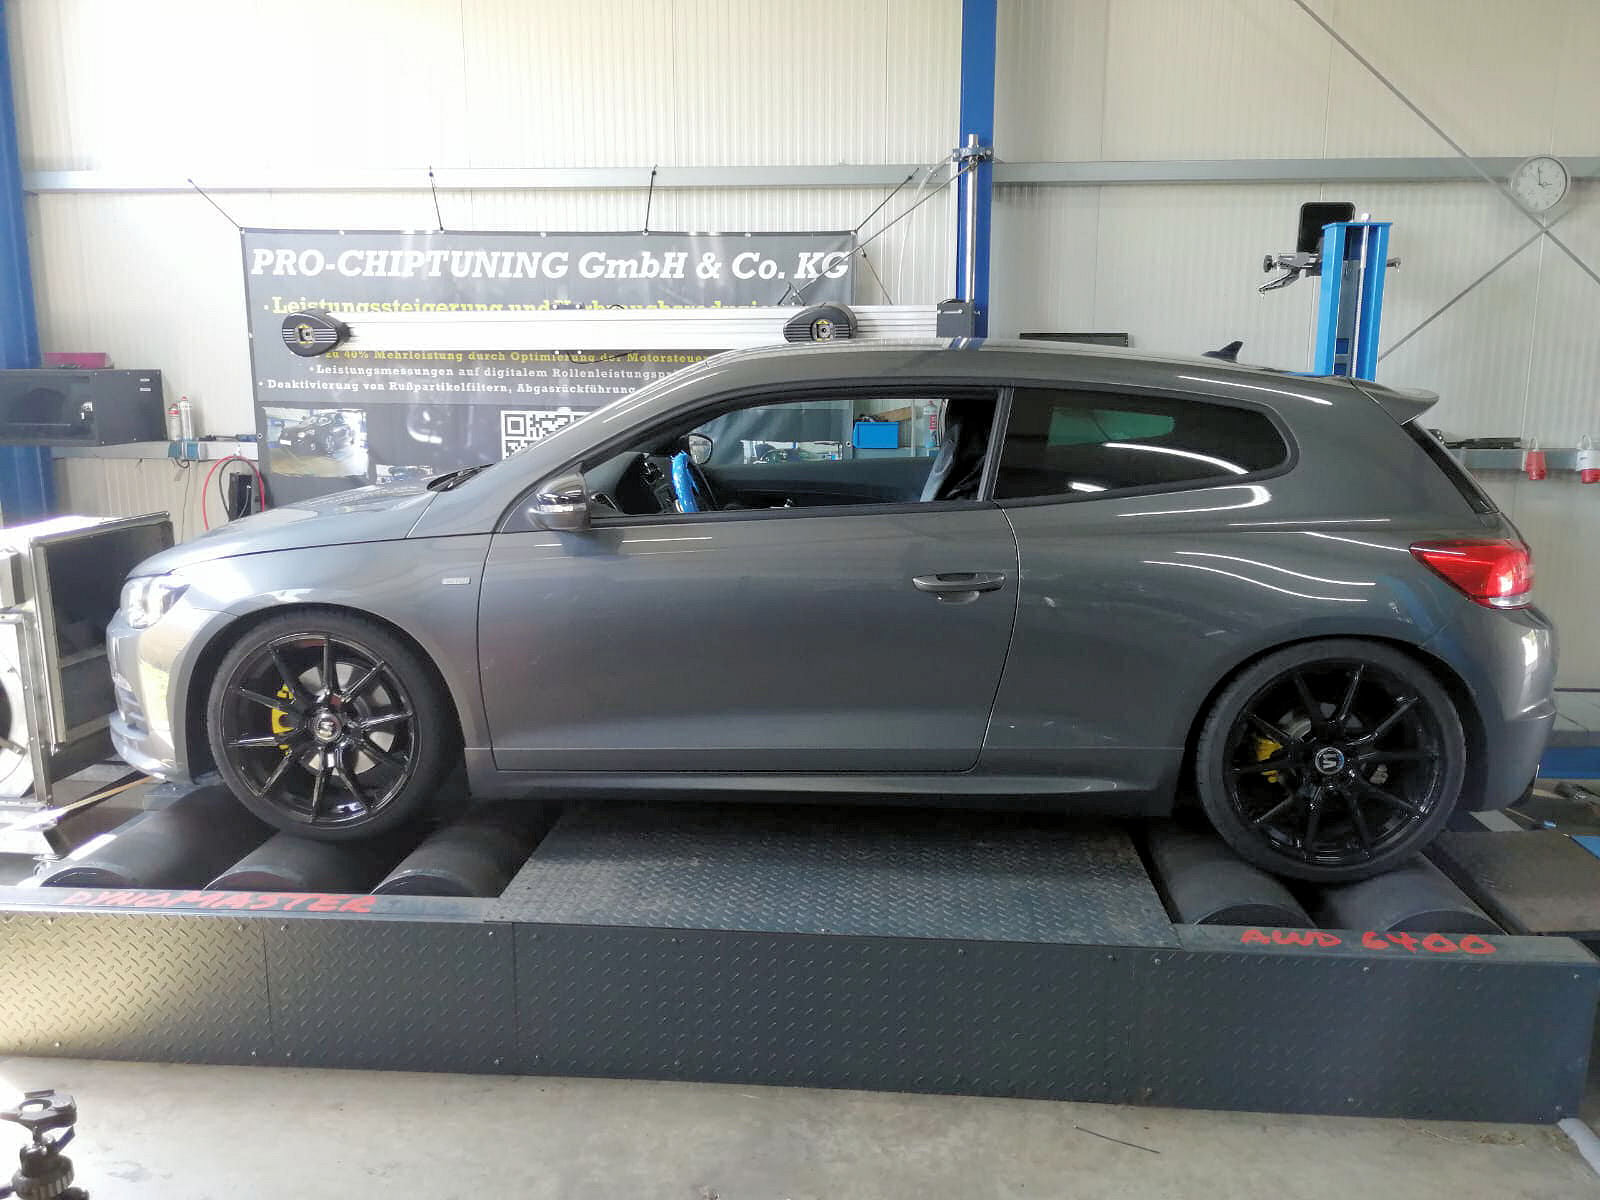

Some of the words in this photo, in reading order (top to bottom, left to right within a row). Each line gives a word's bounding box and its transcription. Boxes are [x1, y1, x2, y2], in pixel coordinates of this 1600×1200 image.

[251, 249, 569, 279] PRO-CHIPTUNING
[578, 251, 688, 280] GmbH
[696, 252, 721, 279] &
[731, 250, 786, 281] Co.
[793, 251, 850, 280] KG
[373, 352, 463, 362] Mehrleistung
[468, 352, 506, 362] durch
[316, 365, 454, 377] Leistungsmessungen
[458, 367, 480, 377] auf
[484, 367, 548, 379] digitalem
[266, 379, 359, 392] Deaktivierung
[363, 383, 385, 391] von
[1241, 929, 1342, 947] AWD
[1361, 931, 1496, 954] 6400
